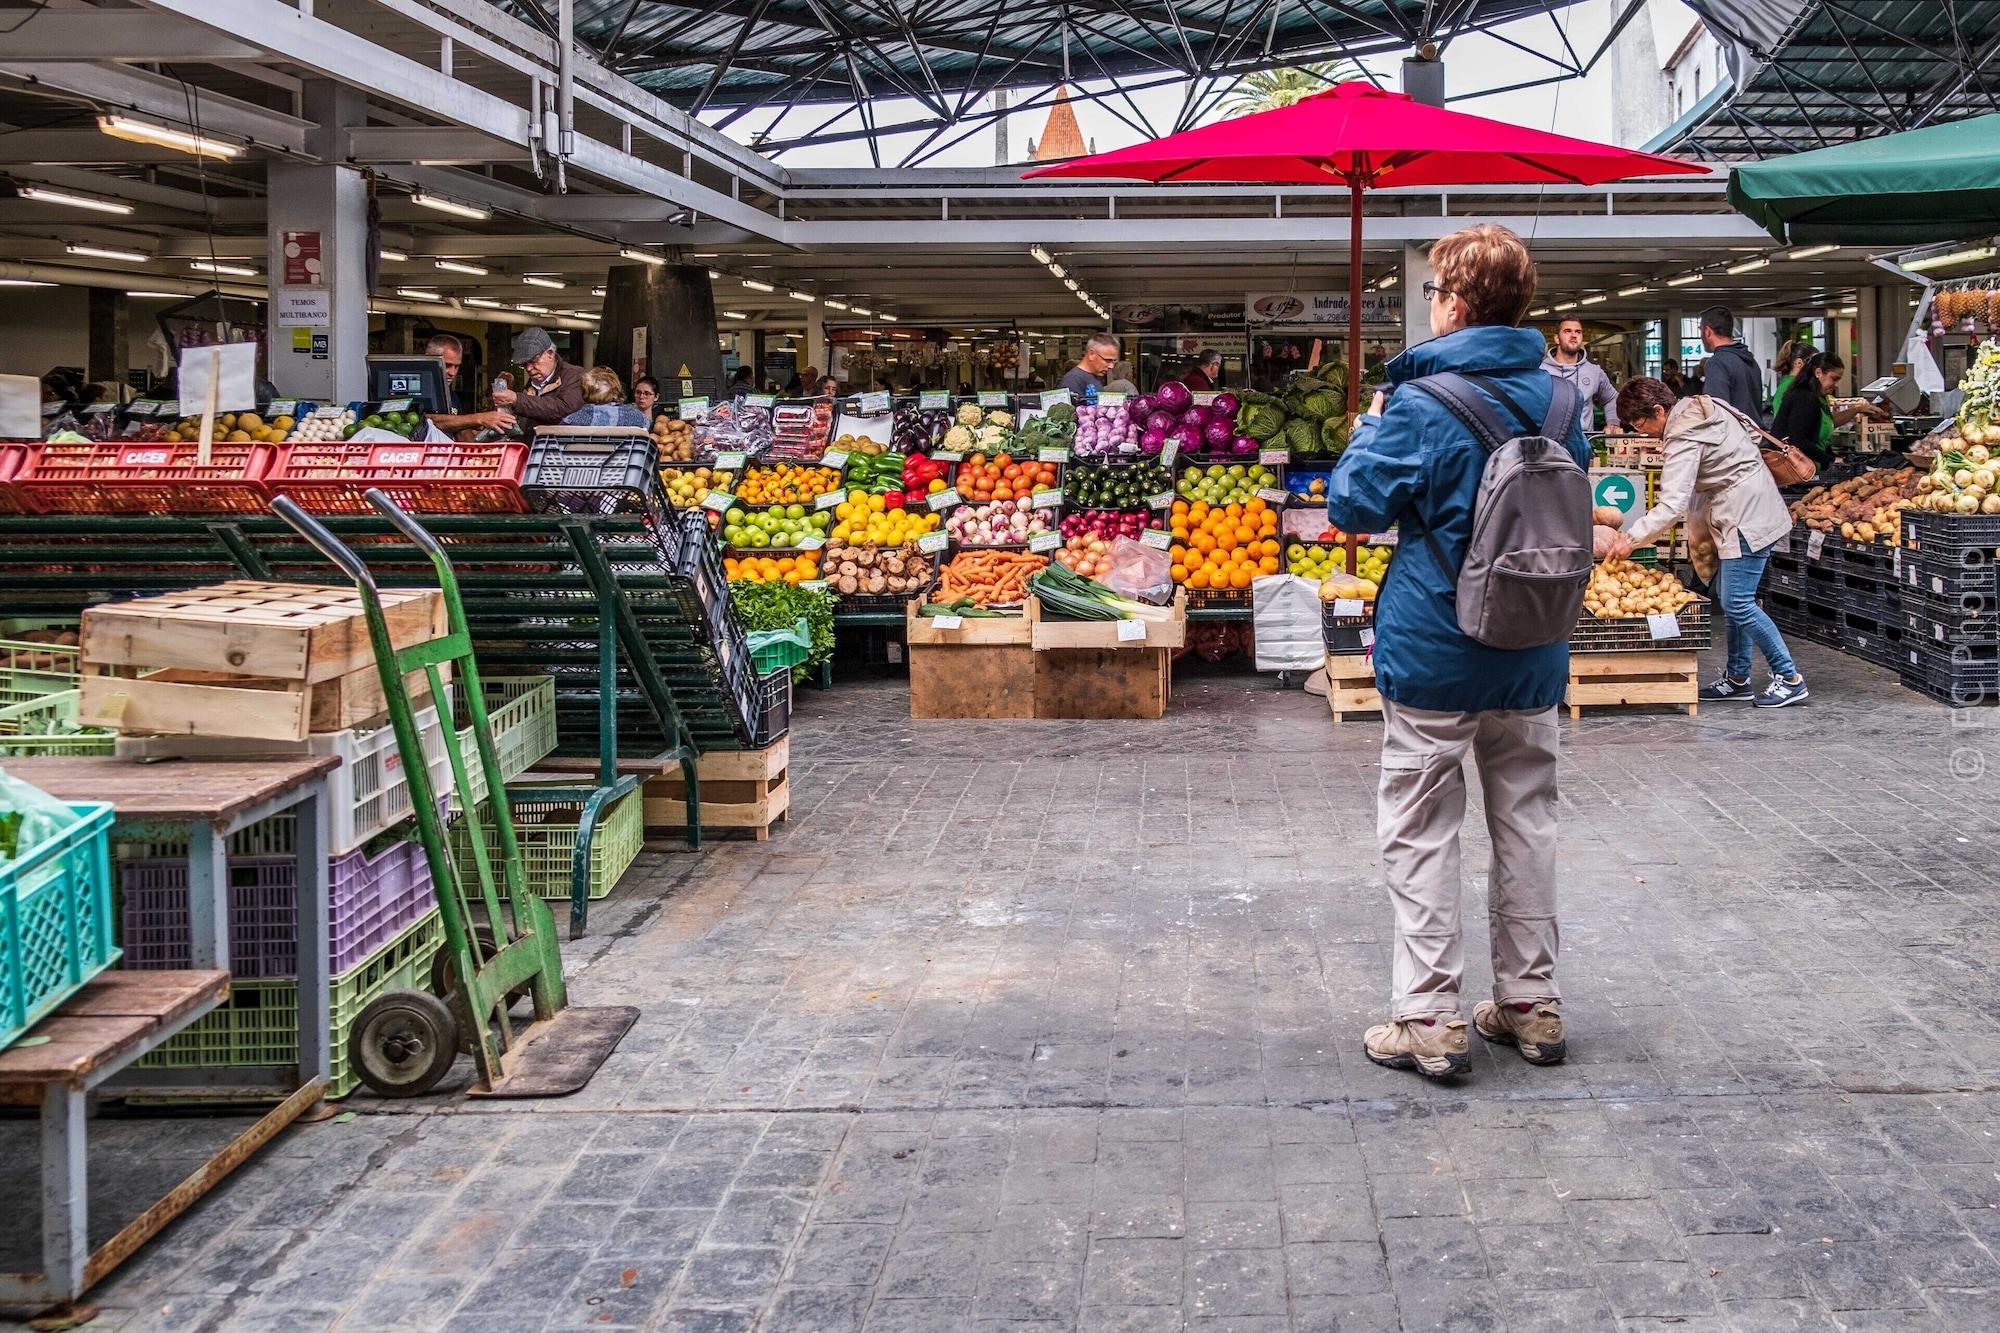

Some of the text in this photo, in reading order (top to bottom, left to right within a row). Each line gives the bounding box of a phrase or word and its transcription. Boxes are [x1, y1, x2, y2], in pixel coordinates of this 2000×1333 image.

[1695, 344, 1702, 355] 4
[126, 452, 167, 464] CACER
[379, 452, 419, 464] CACER
